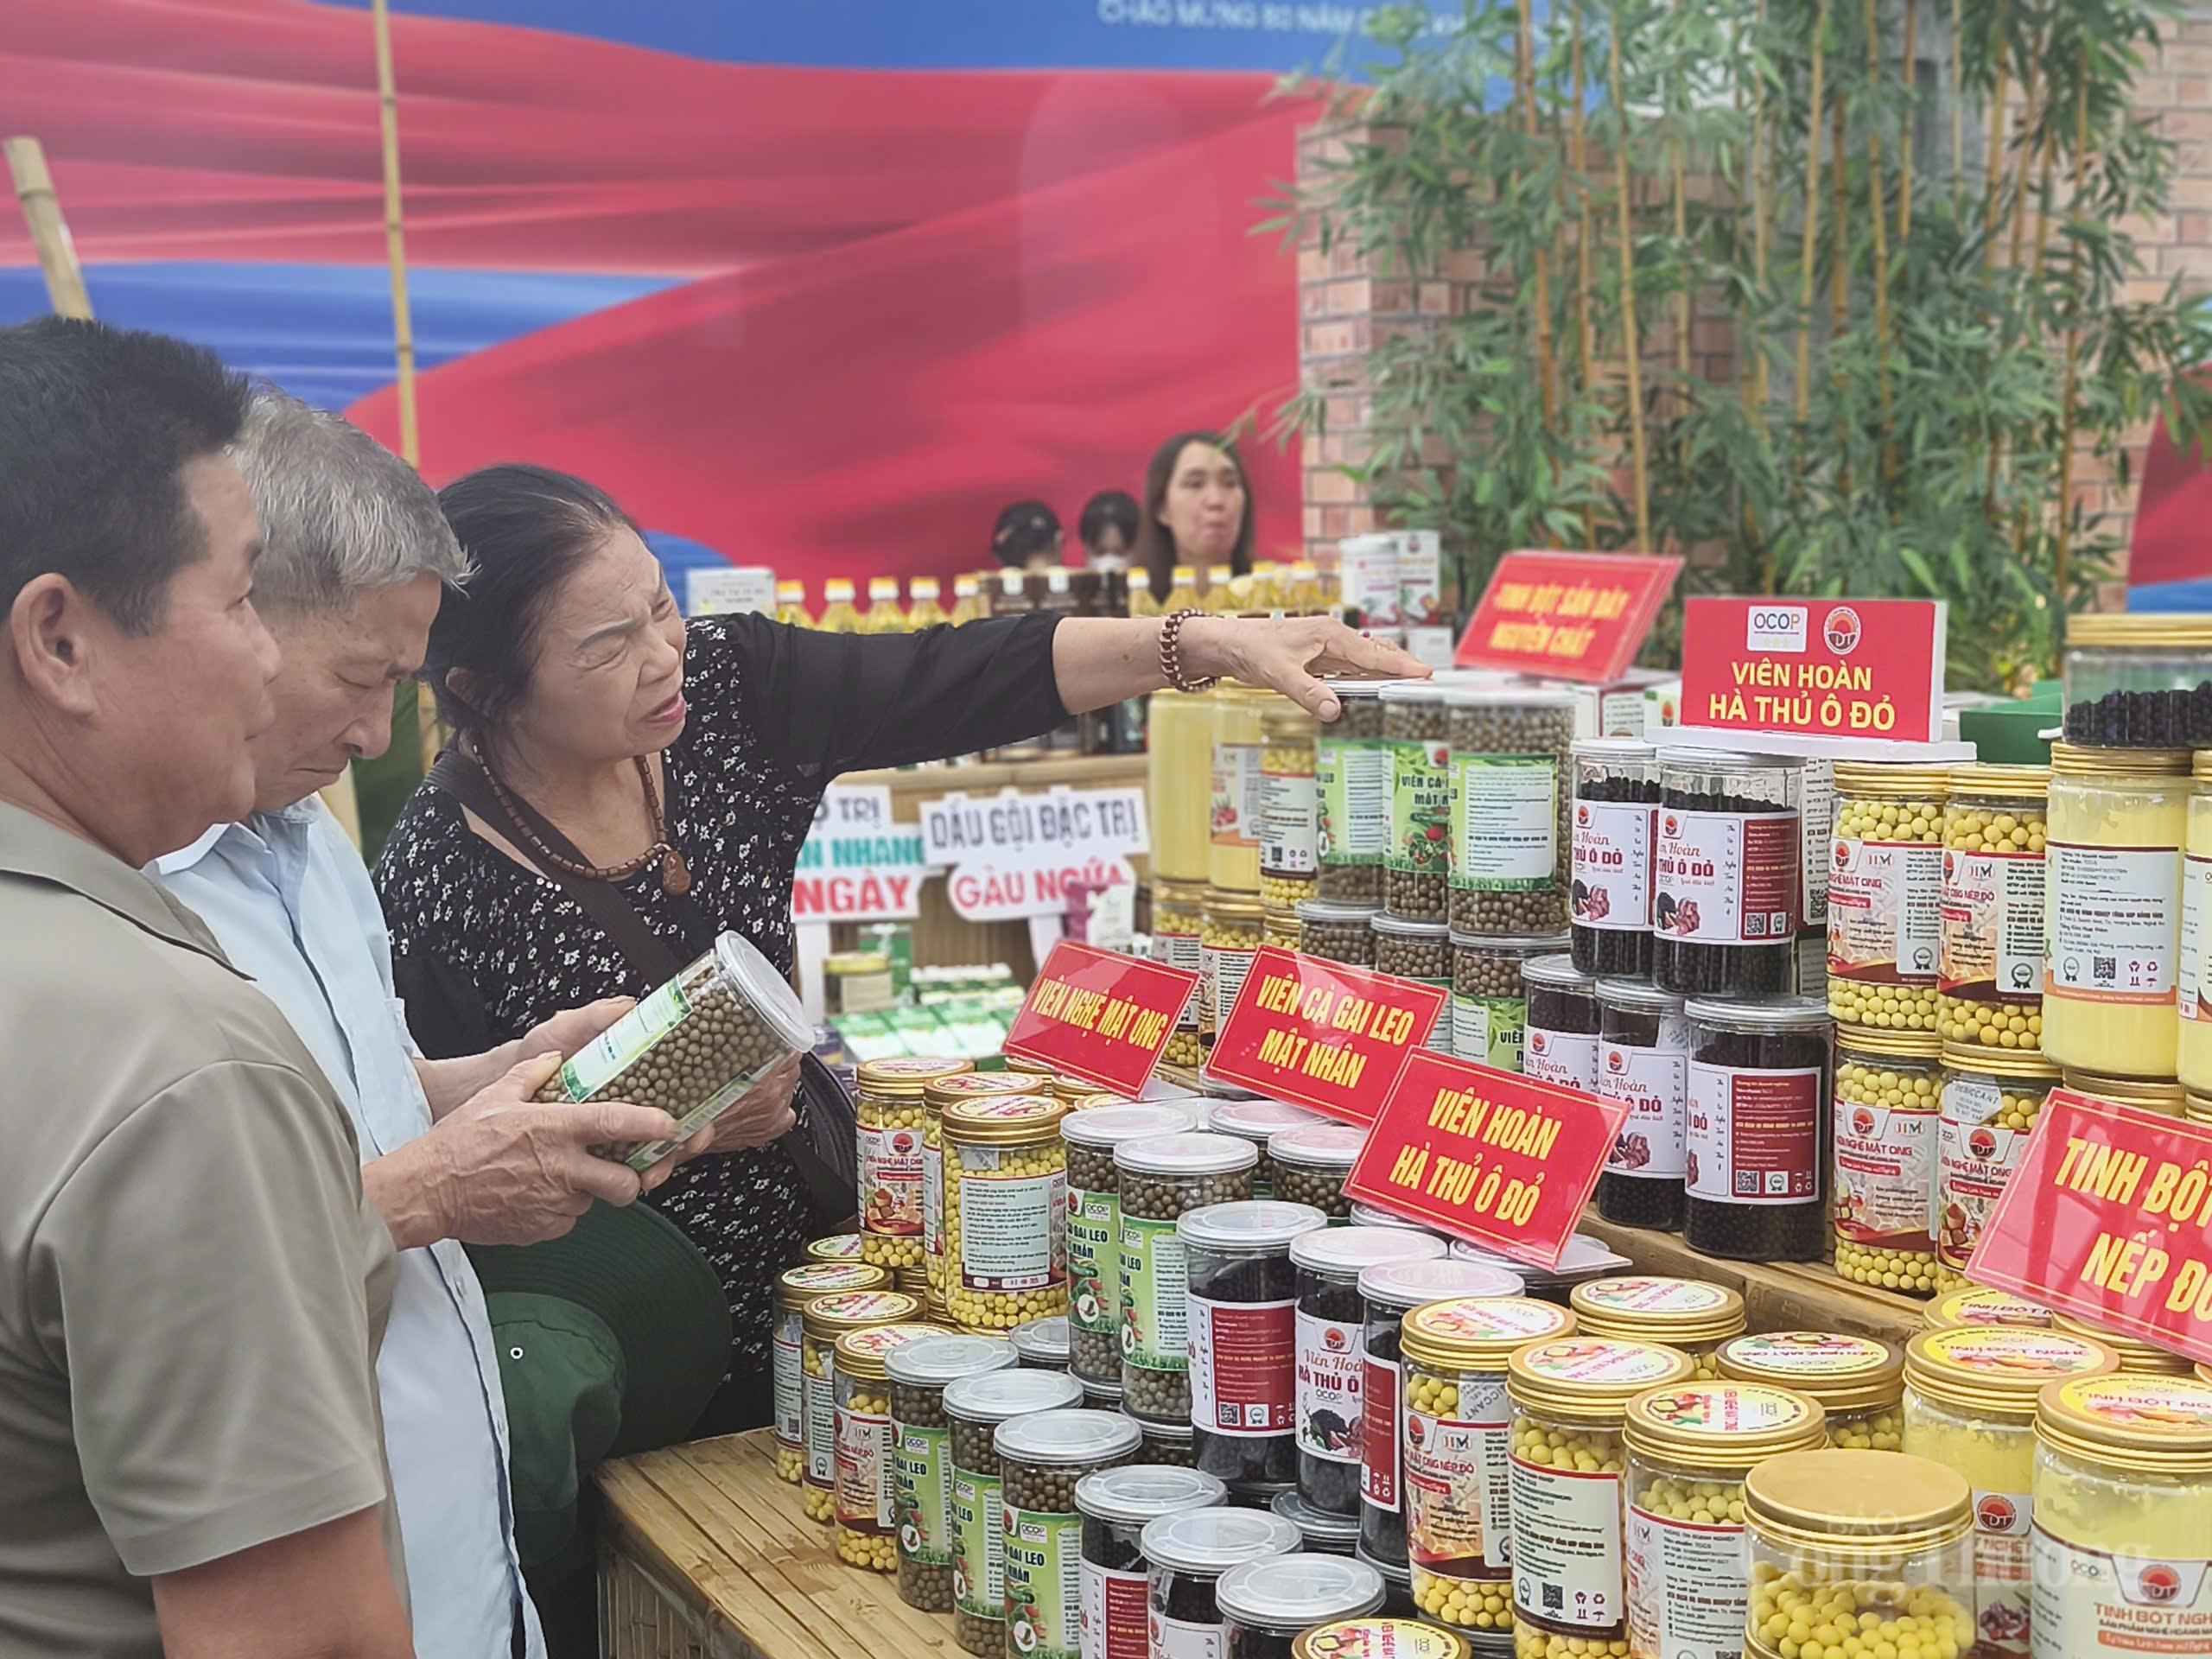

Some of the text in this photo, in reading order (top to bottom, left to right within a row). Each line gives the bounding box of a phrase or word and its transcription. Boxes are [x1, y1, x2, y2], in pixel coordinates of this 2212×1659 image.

[1754, 613, 1800, 630] OCOP
[1732, 658, 1872, 691] VIÊN HOÀN
[1709, 689, 1896, 731] HÀ THỦ Ô ĐỎ
[793, 868, 910, 914] NGÀY
[1031, 975, 1169, 1051] VIÊN NGHỆ MẬT ONG
[1255, 973, 1414, 1046] VIÊN CÀ GAI LEO
[1257, 1027, 1368, 1089] MẬT NHÂN
[1427, 1087, 1562, 1160] VIÊN HOÀN
[1389, 1141, 1546, 1227] HÀ THỦ Ô ĐỎ
[2054, 1137, 2150, 1205] TINH
[1090, 1229, 1108, 1243] LEO
[1128, 1255, 1141, 1271] LEO
[2080, 1229, 2170, 1299] NẾP
[1313, 1371, 1342, 1390] THỦ
[1347, 1376, 1359, 1393] Ô
[910, 1461, 926, 1475] LEO
[958, 1506, 973, 1522] LEO
[1025, 1551, 1045, 1567] LEO
[2094, 1602, 2133, 1621] TINH
[2178, 1613, 2212, 1626] NGH
